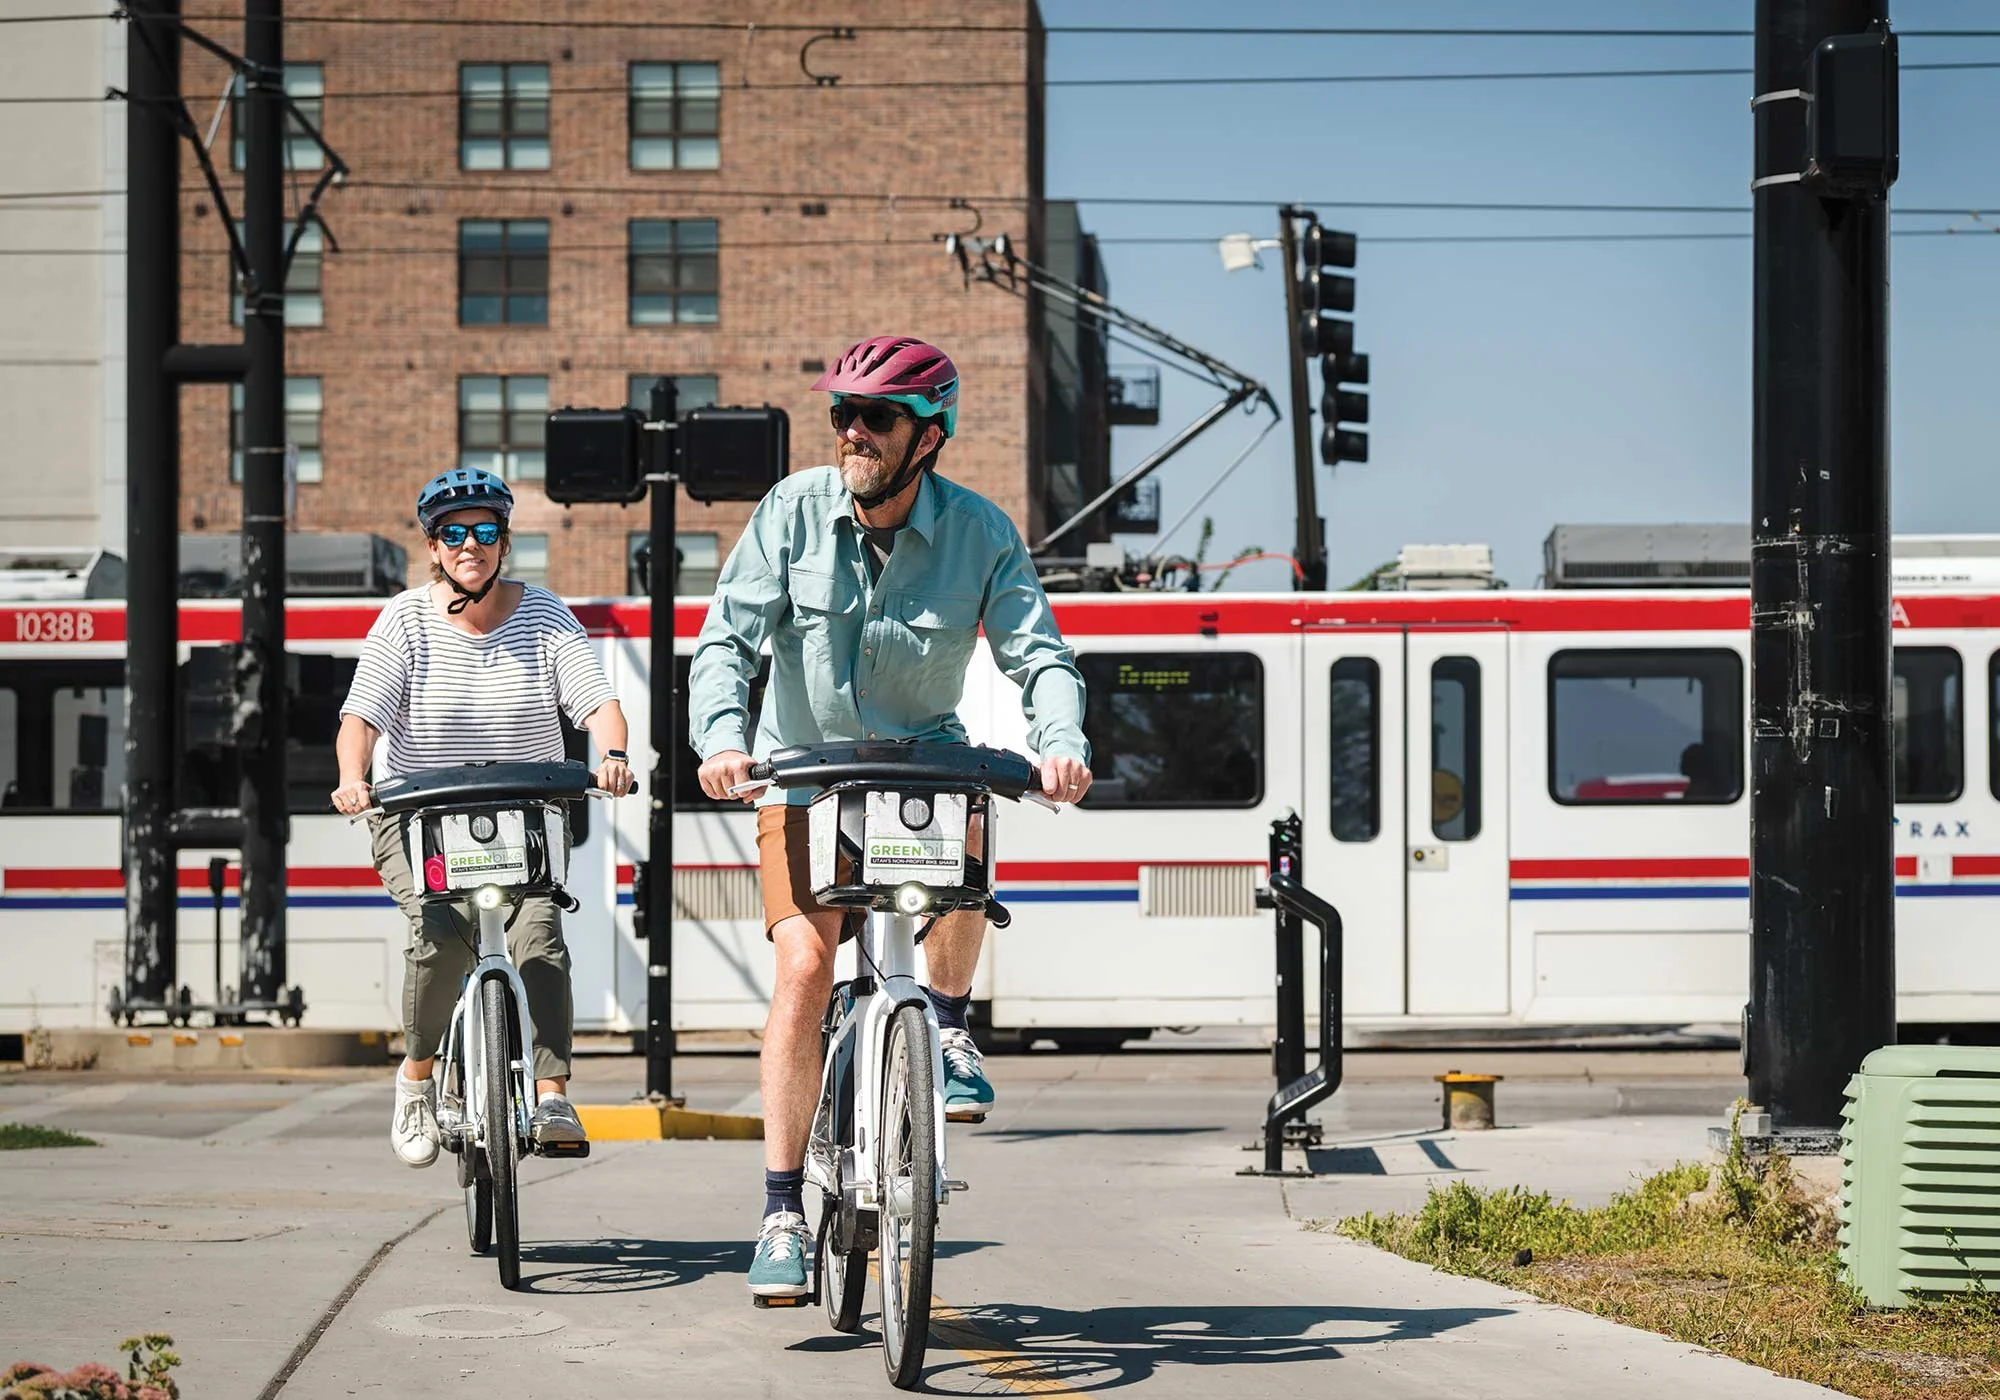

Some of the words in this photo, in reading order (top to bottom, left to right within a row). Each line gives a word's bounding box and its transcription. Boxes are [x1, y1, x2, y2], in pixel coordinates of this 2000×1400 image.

[15, 611, 94, 641] 1038B
[1894, 817, 1970, 838] RAX
[871, 842, 959, 857] GREENbike
